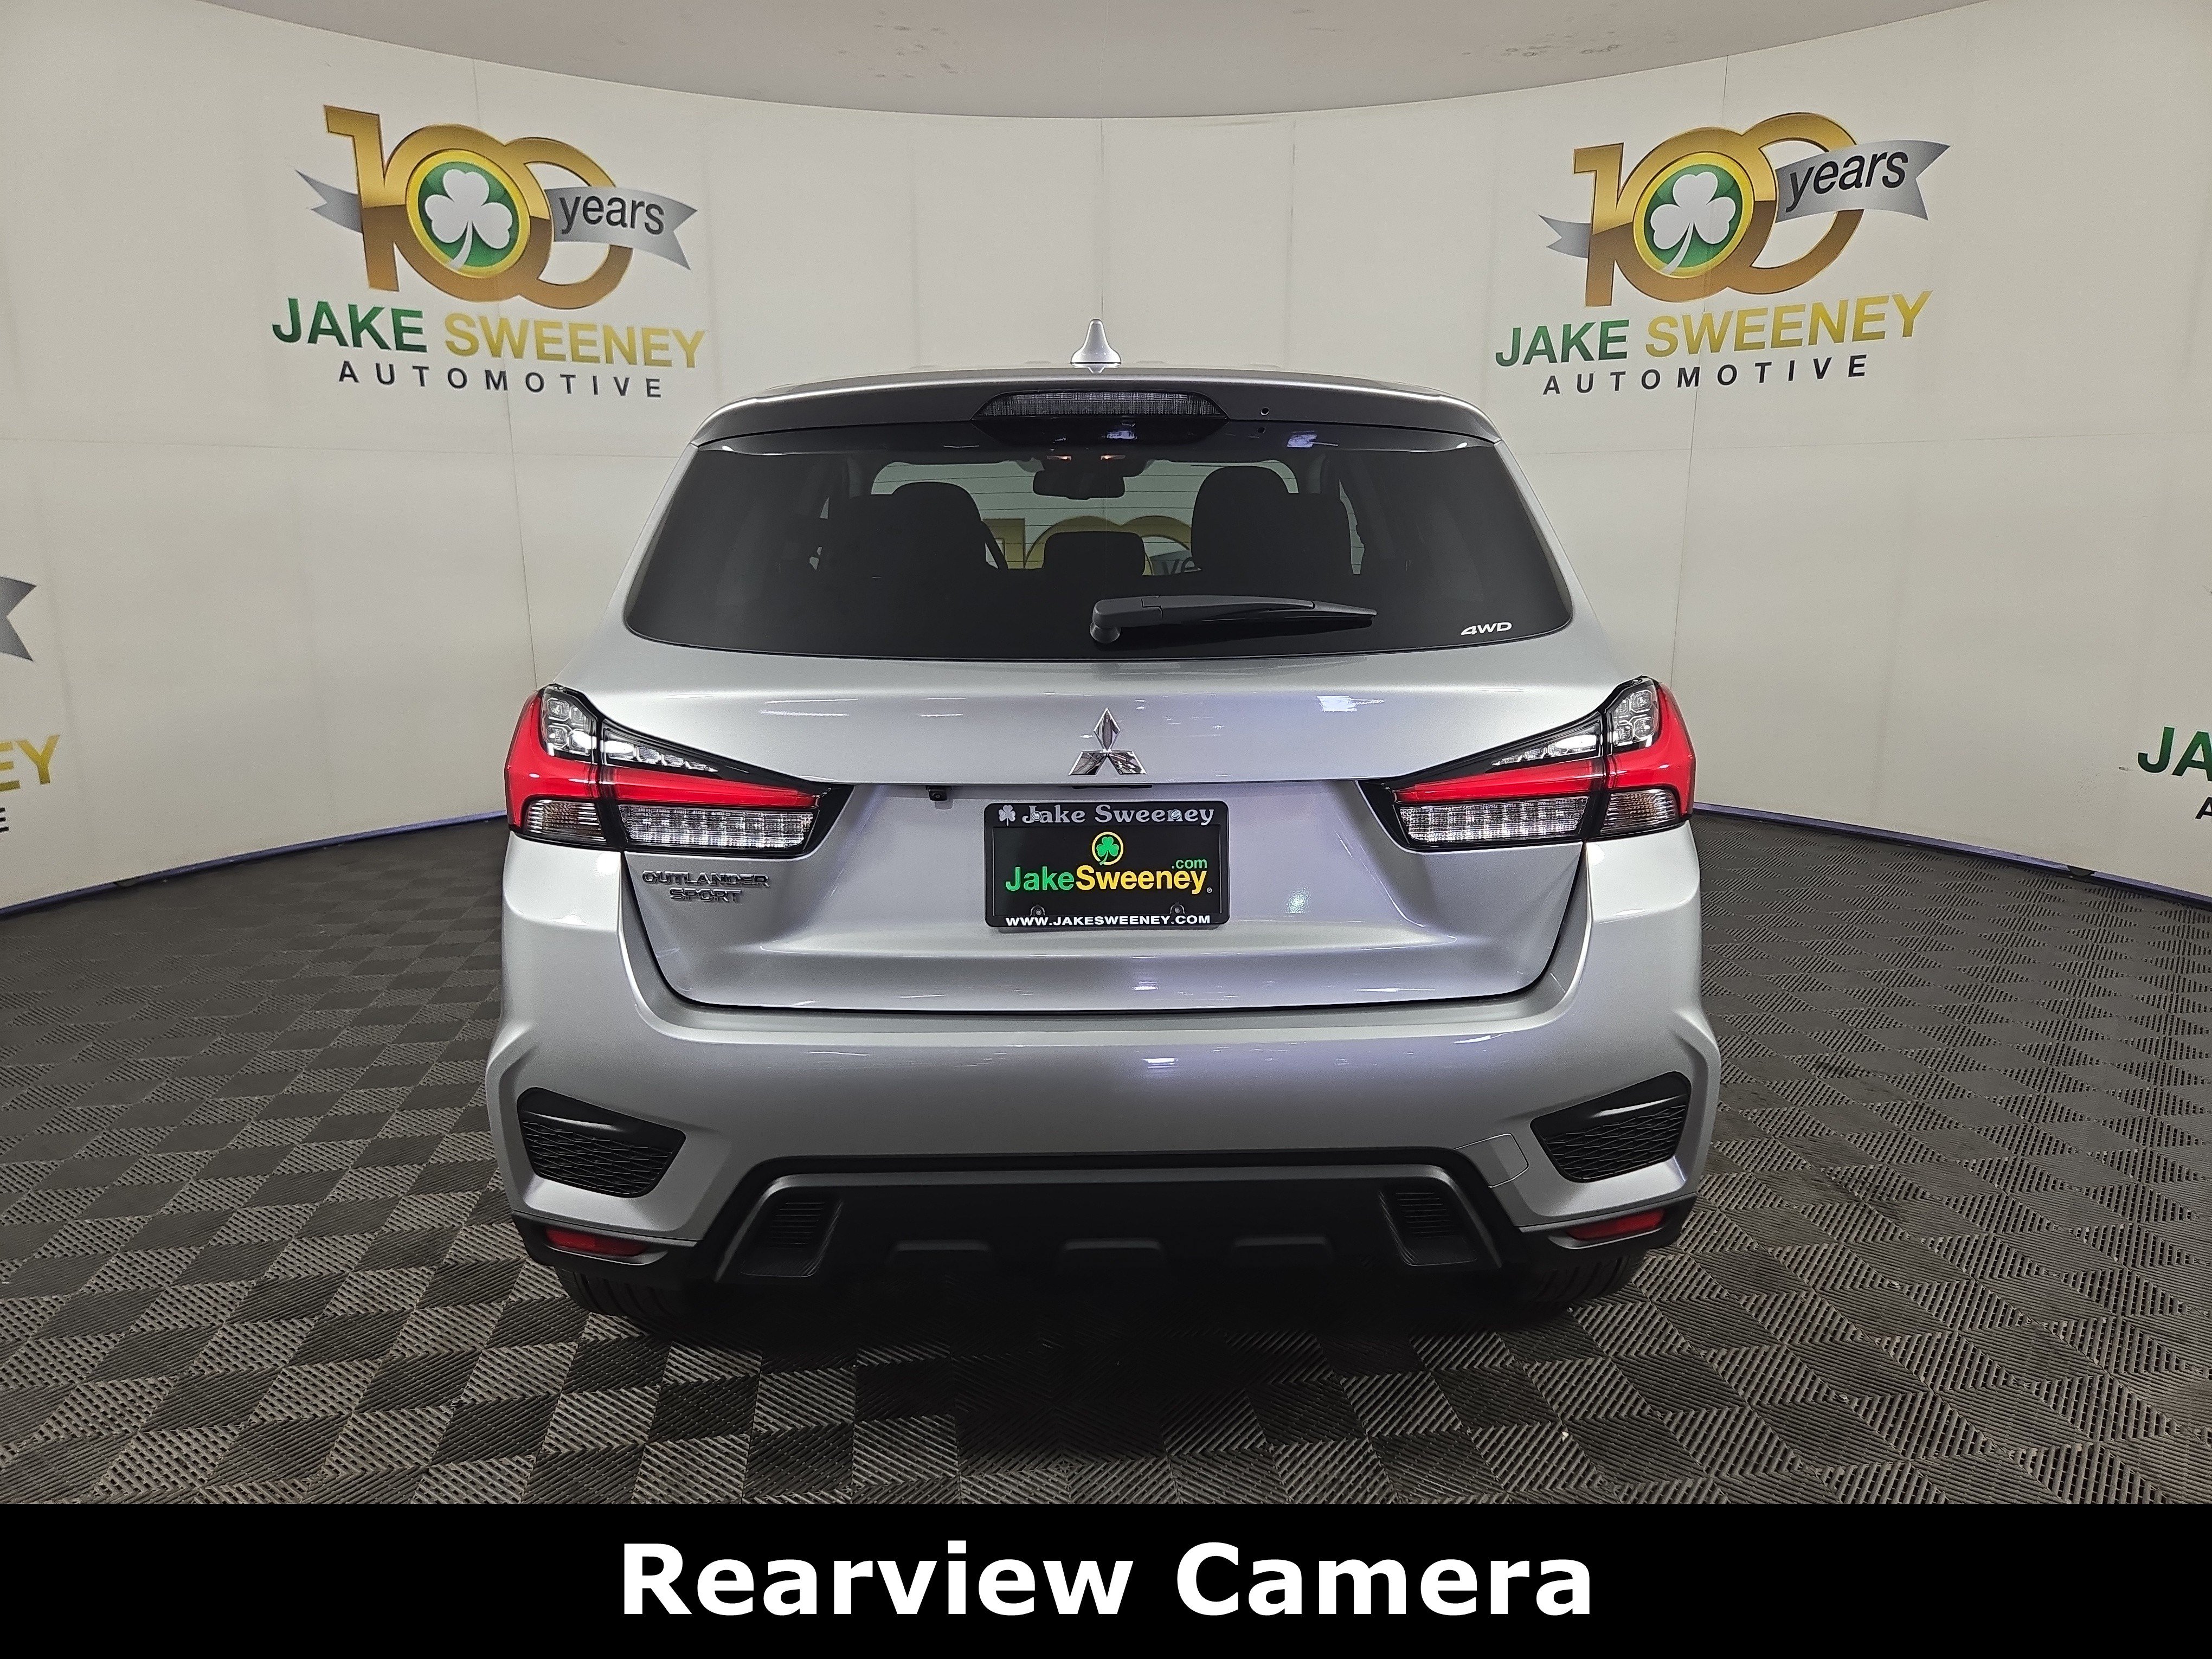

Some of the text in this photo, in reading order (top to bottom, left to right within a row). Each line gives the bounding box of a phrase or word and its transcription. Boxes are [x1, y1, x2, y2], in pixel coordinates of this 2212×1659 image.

[1785, 151, 1908, 213] years
[560, 195, 665, 235] years
[272, 298, 705, 369] JAKE SWEENEY
[1495, 290, 1932, 368] JAKE SWEENEY
[338, 361, 663, 398] AUTOMOTIVE
[1543, 355, 1867, 395] AUTOMOTIVE
[1461, 622, 1512, 635] 4WD
[1023, 805, 1086, 823] Jake
[1172, 859, 1207, 869] .com
[642, 870, 770, 888] OUTLANDER
[669, 887, 742, 902] SPORT
[1006, 915, 1211, 926] WWW.JAKESWEENEY.COM
